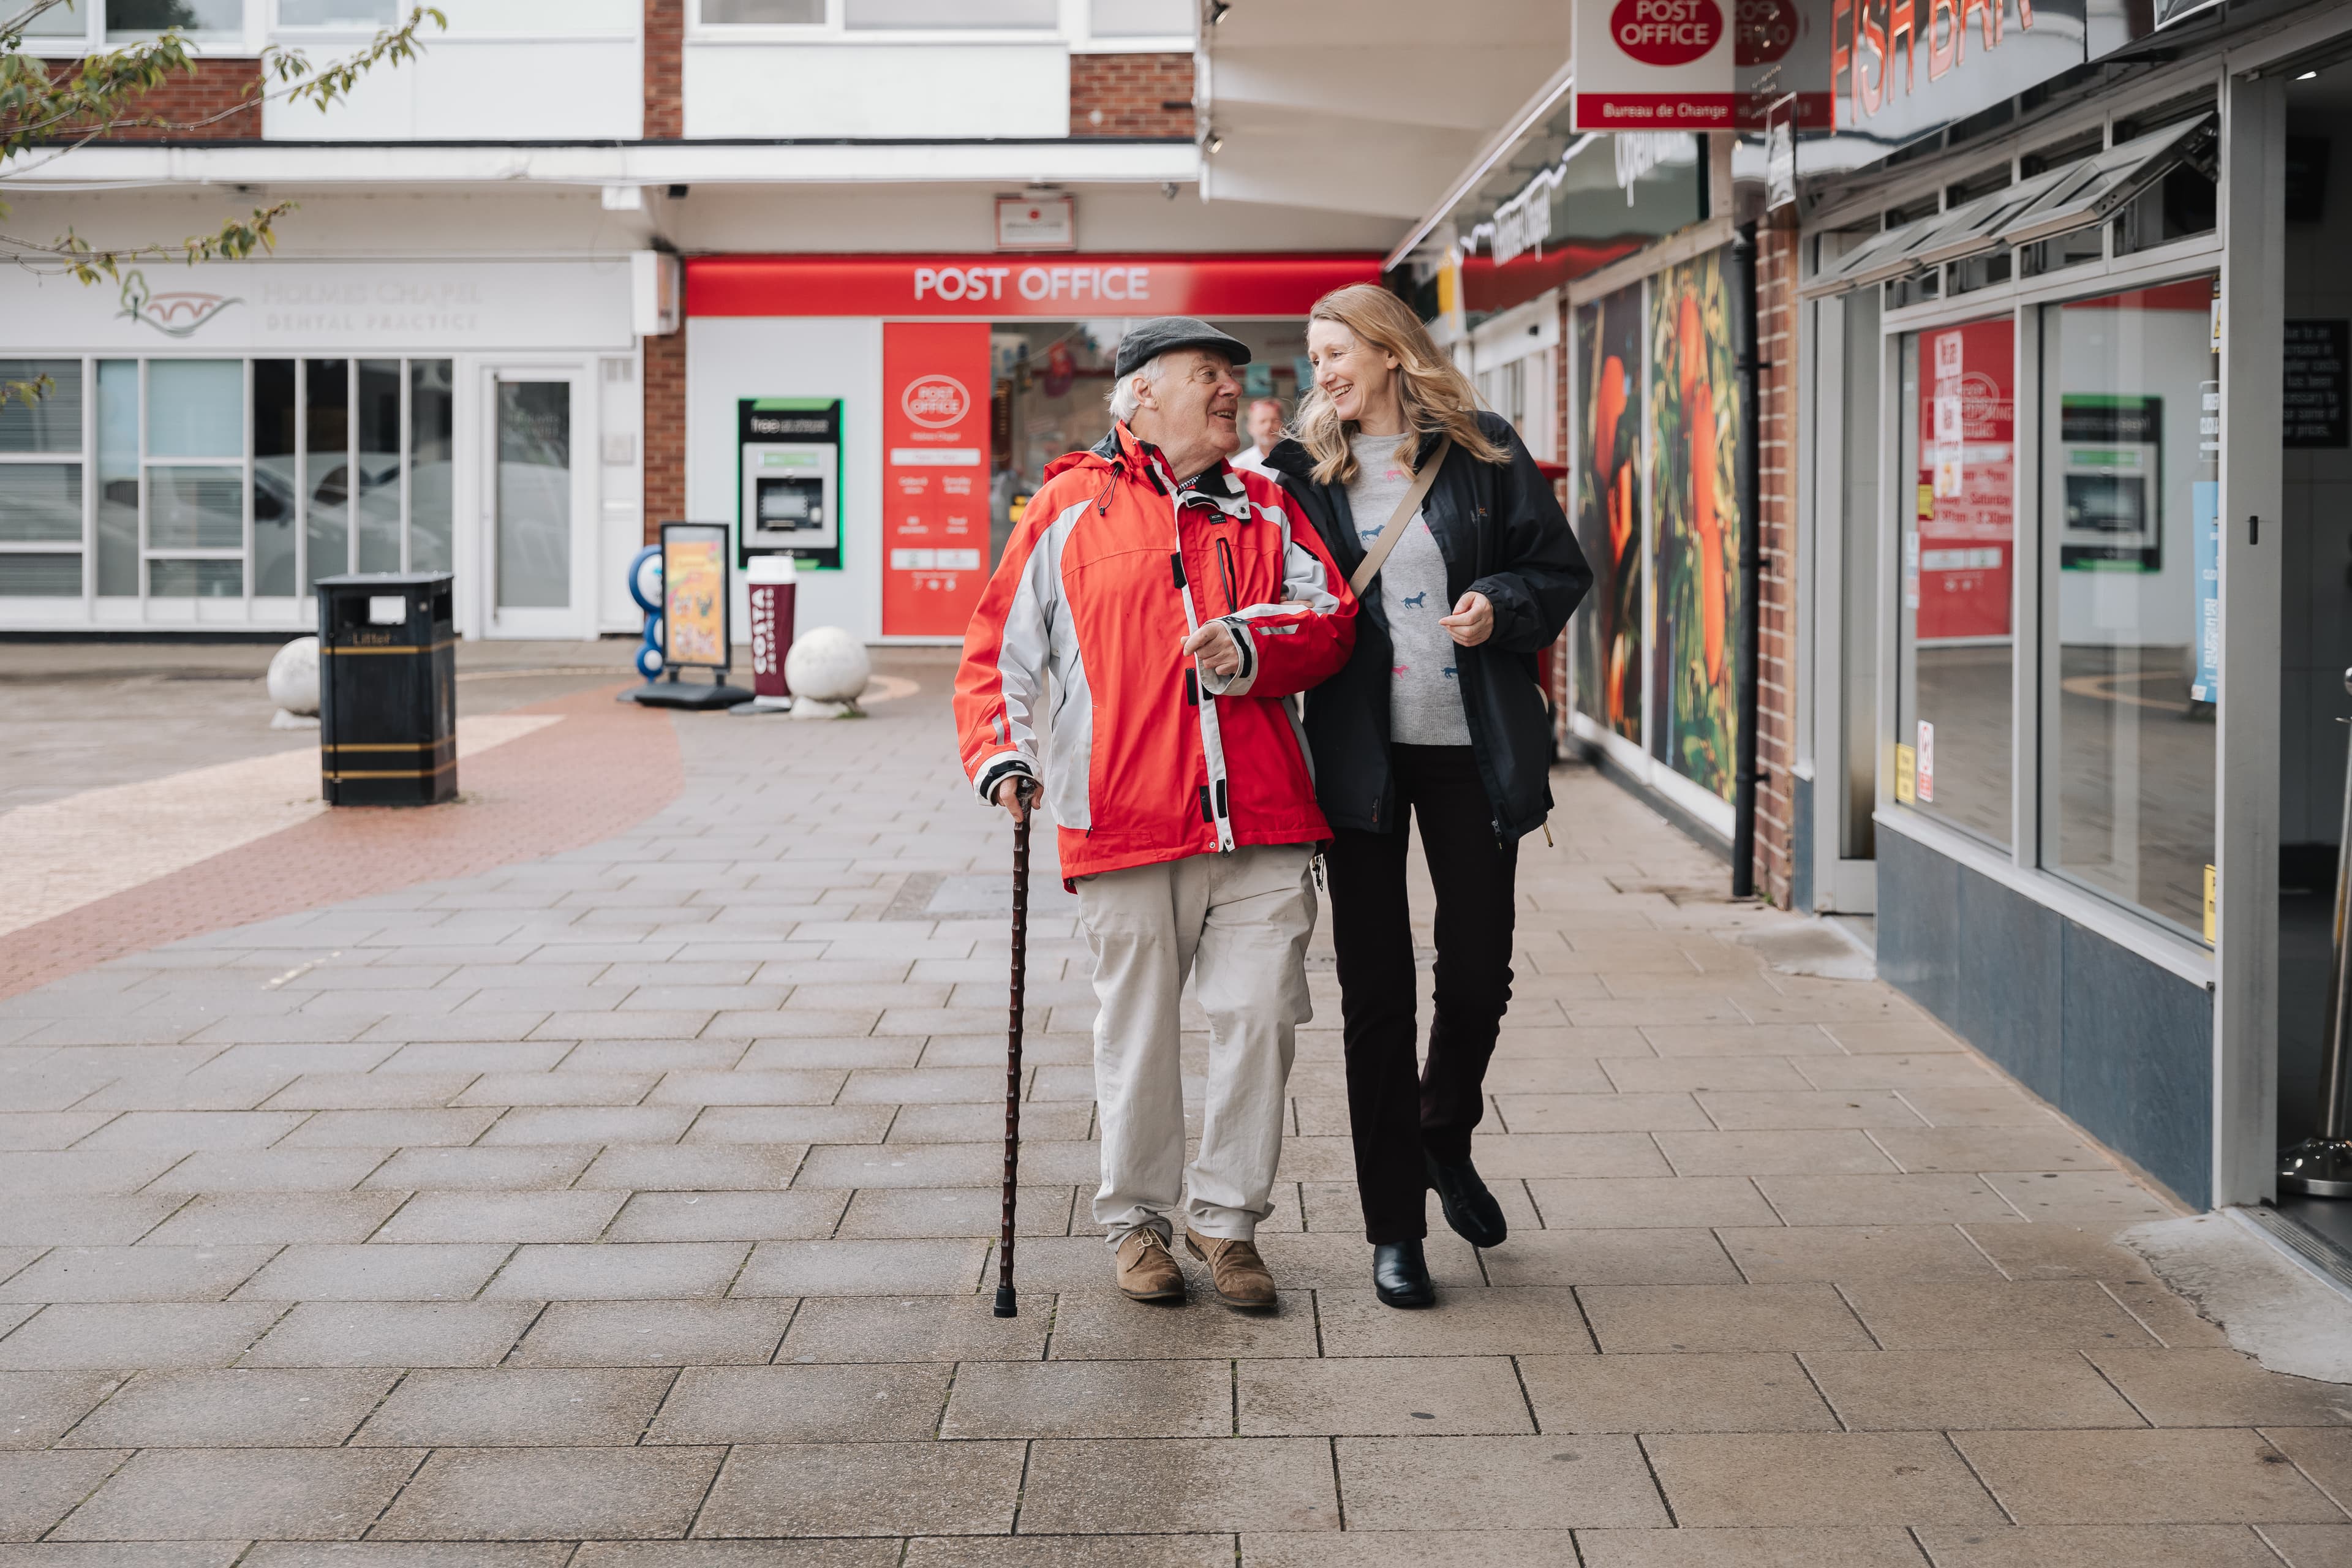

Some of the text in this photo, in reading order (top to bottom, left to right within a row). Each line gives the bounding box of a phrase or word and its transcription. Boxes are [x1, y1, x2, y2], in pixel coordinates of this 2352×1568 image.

[1636, 0, 1701, 21] POST
[1620, 23, 1709, 45] OFFICE
[1831, 0, 1915, 138] FISH
[1603, 103, 1653, 118] Bureau
[1656, 103, 1674, 118] de
[1677, 103, 1728, 120] Change
[914, 267, 1150, 301] POST OFFICE
[918, 386, 956, 399] POST
[910, 399, 960, 415] OFFICE
[752, 588, 767, 674] COSTA
